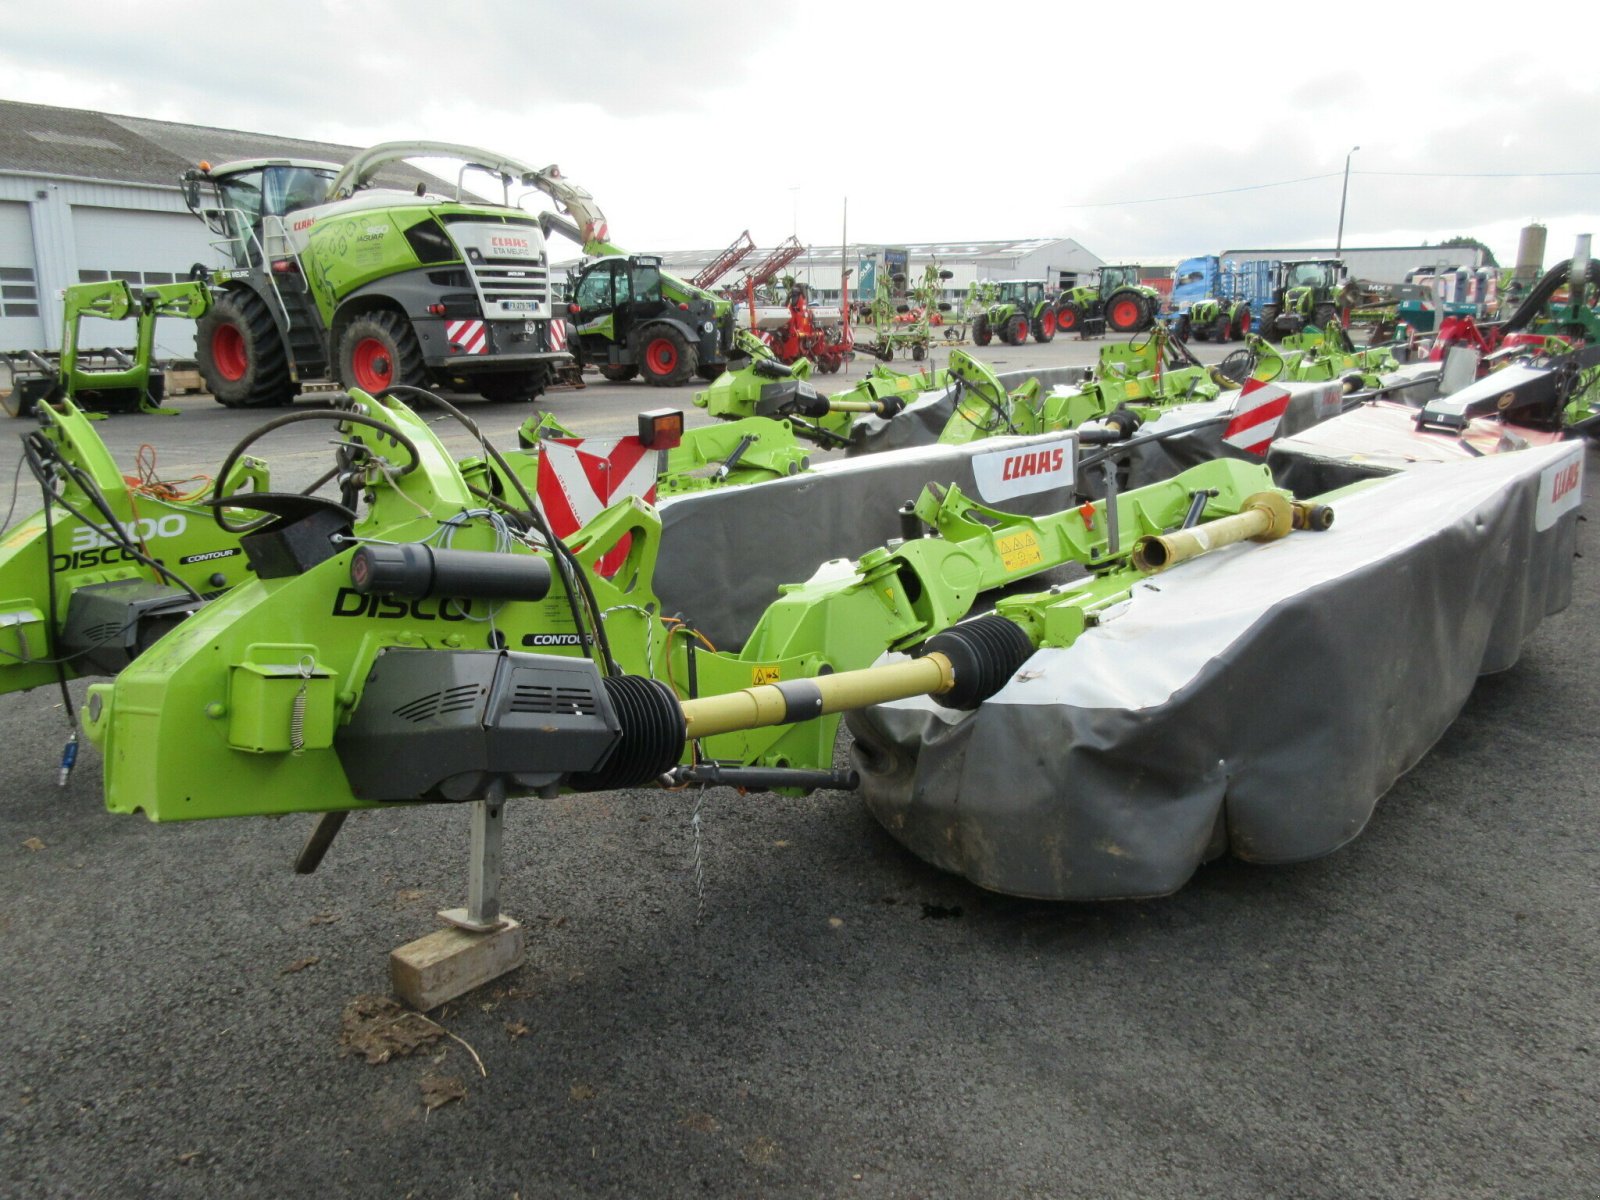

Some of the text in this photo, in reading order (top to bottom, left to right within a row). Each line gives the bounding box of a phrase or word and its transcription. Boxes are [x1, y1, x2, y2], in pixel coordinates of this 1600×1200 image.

[293, 217, 316, 231] CLAAS
[356, 233, 384, 242] JAGUAR
[491, 237, 529, 247] CLAAS
[493, 247, 506, 255] ETA
[1002, 448, 1064, 481] CLAAS
[1551, 461, 1580, 504] CLAAS
[186, 549, 234, 564] CONTOUR
[332, 587, 473, 622] DISCO
